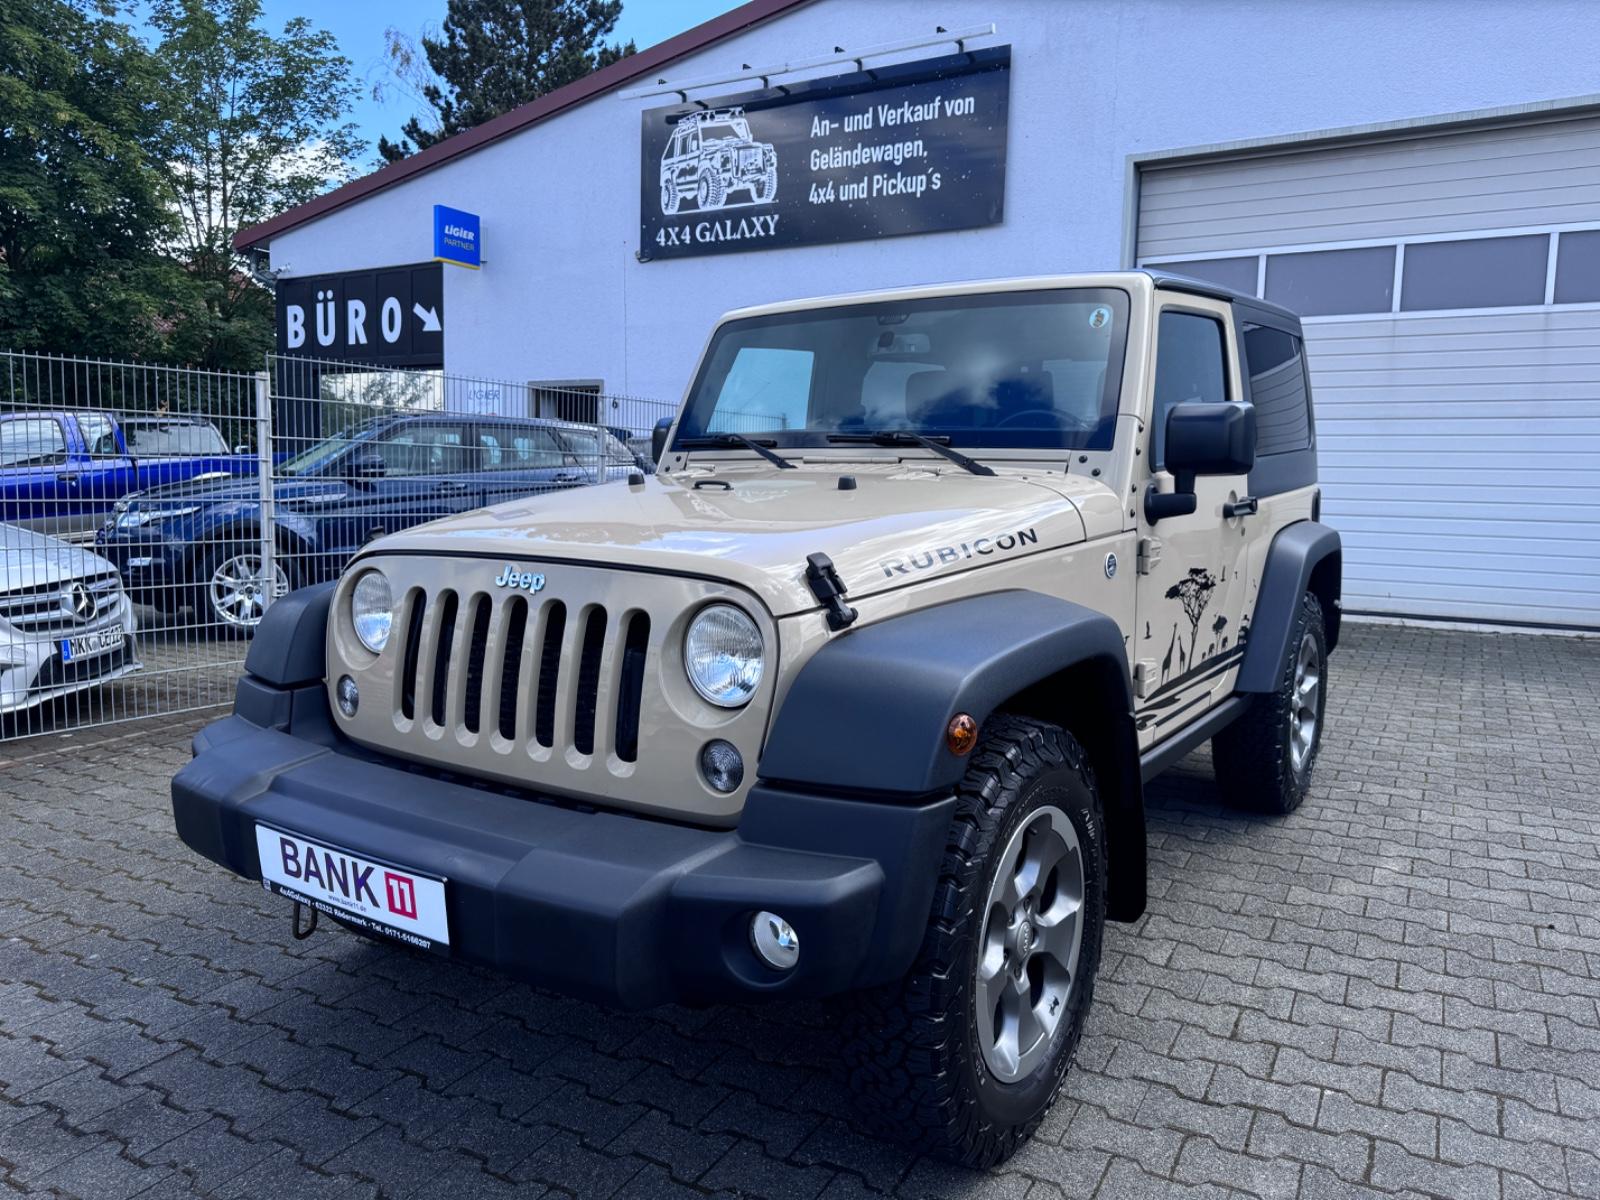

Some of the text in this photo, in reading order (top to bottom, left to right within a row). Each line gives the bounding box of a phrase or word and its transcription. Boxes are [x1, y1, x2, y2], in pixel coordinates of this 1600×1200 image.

[810, 95, 975, 138] An- und Verkauf von
[810, 139, 928, 171] Geländewagen,
[808, 181, 835, 205] 4x4
[839, 176, 868, 201] und
[444, 236, 475, 252] PARTNER
[695, 214, 779, 243] GALAXY
[286, 289, 402, 349] BÜRO
[879, 528, 1039, 577] RUBICON
[495, 564, 546, 595] Jeep
[279, 836, 414, 915] BANK 11
